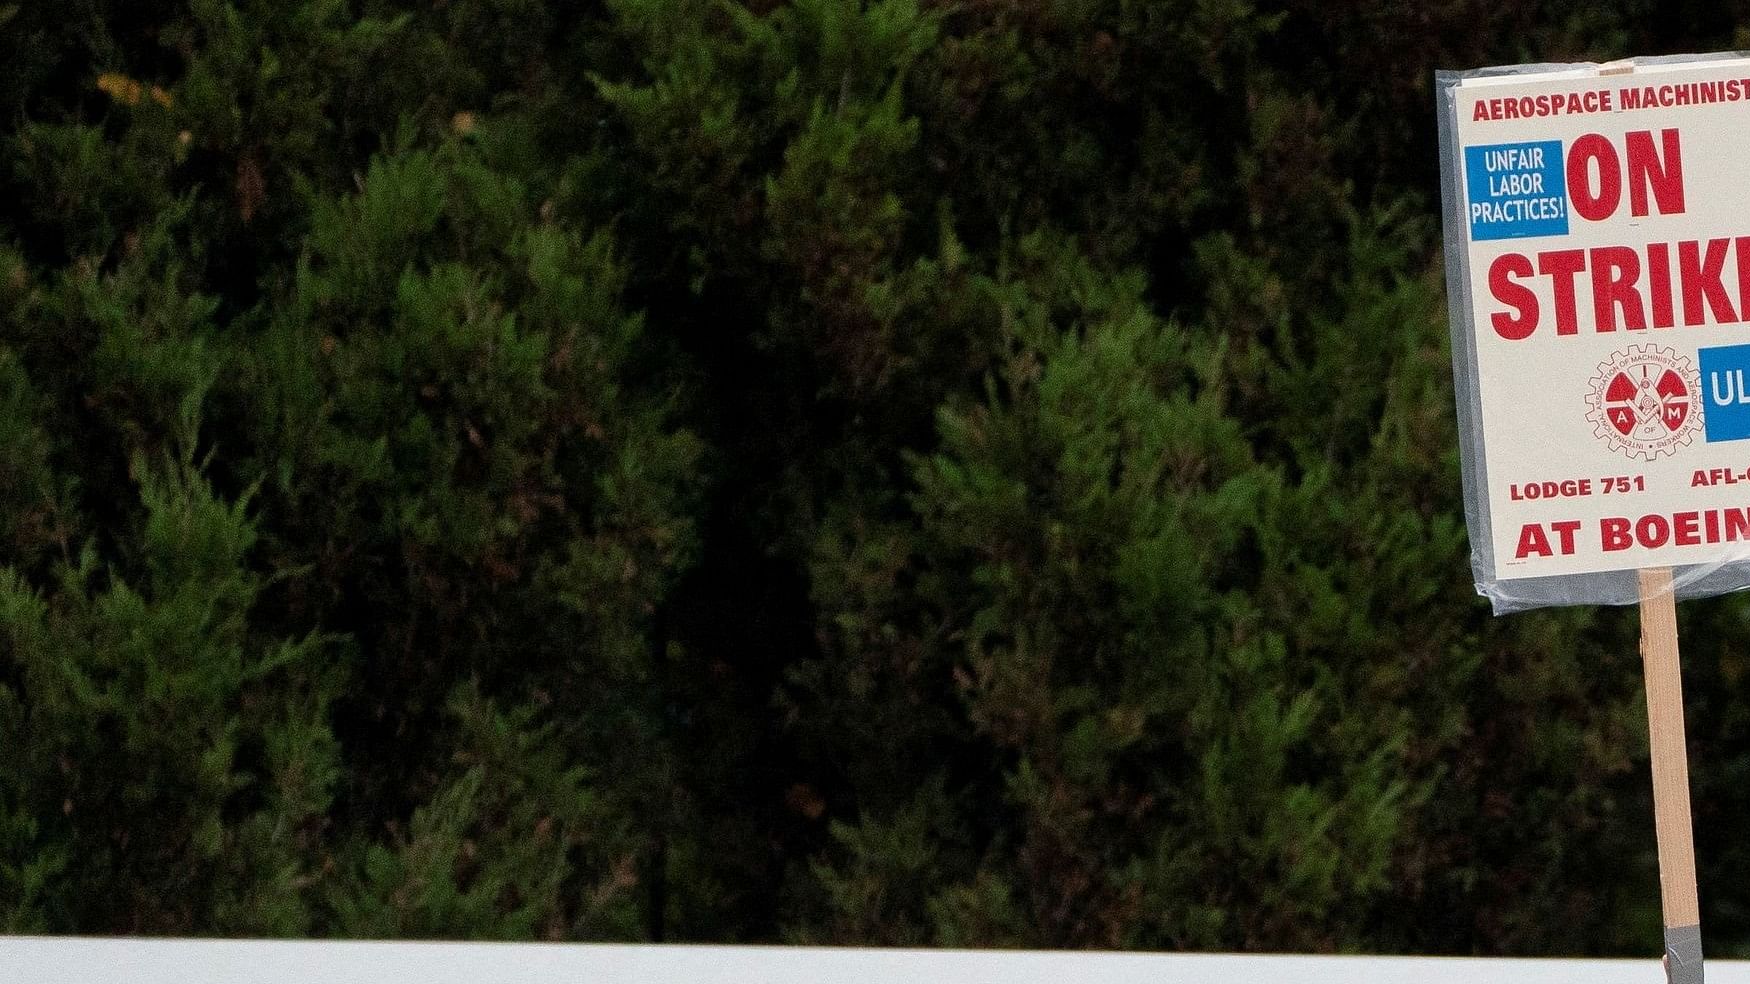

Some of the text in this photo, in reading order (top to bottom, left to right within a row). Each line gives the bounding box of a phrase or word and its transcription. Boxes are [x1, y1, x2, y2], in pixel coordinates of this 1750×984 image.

[1472, 90, 1612, 122] AEROSPACE
[1485, 147, 1545, 172] UNFAIR
[1489, 173, 1544, 197] LABOR
[1566, 128, 1686, 222] ON
[1471, 197, 1565, 224] PRACTICES!
[1631, 354, 1676, 368] MACHINISTS
[1676, 366, 1690, 379] AND
[1643, 426, 1656, 434] OF
[1509, 474, 1646, 501] LODGE 751
[1514, 520, 1582, 559] AT
